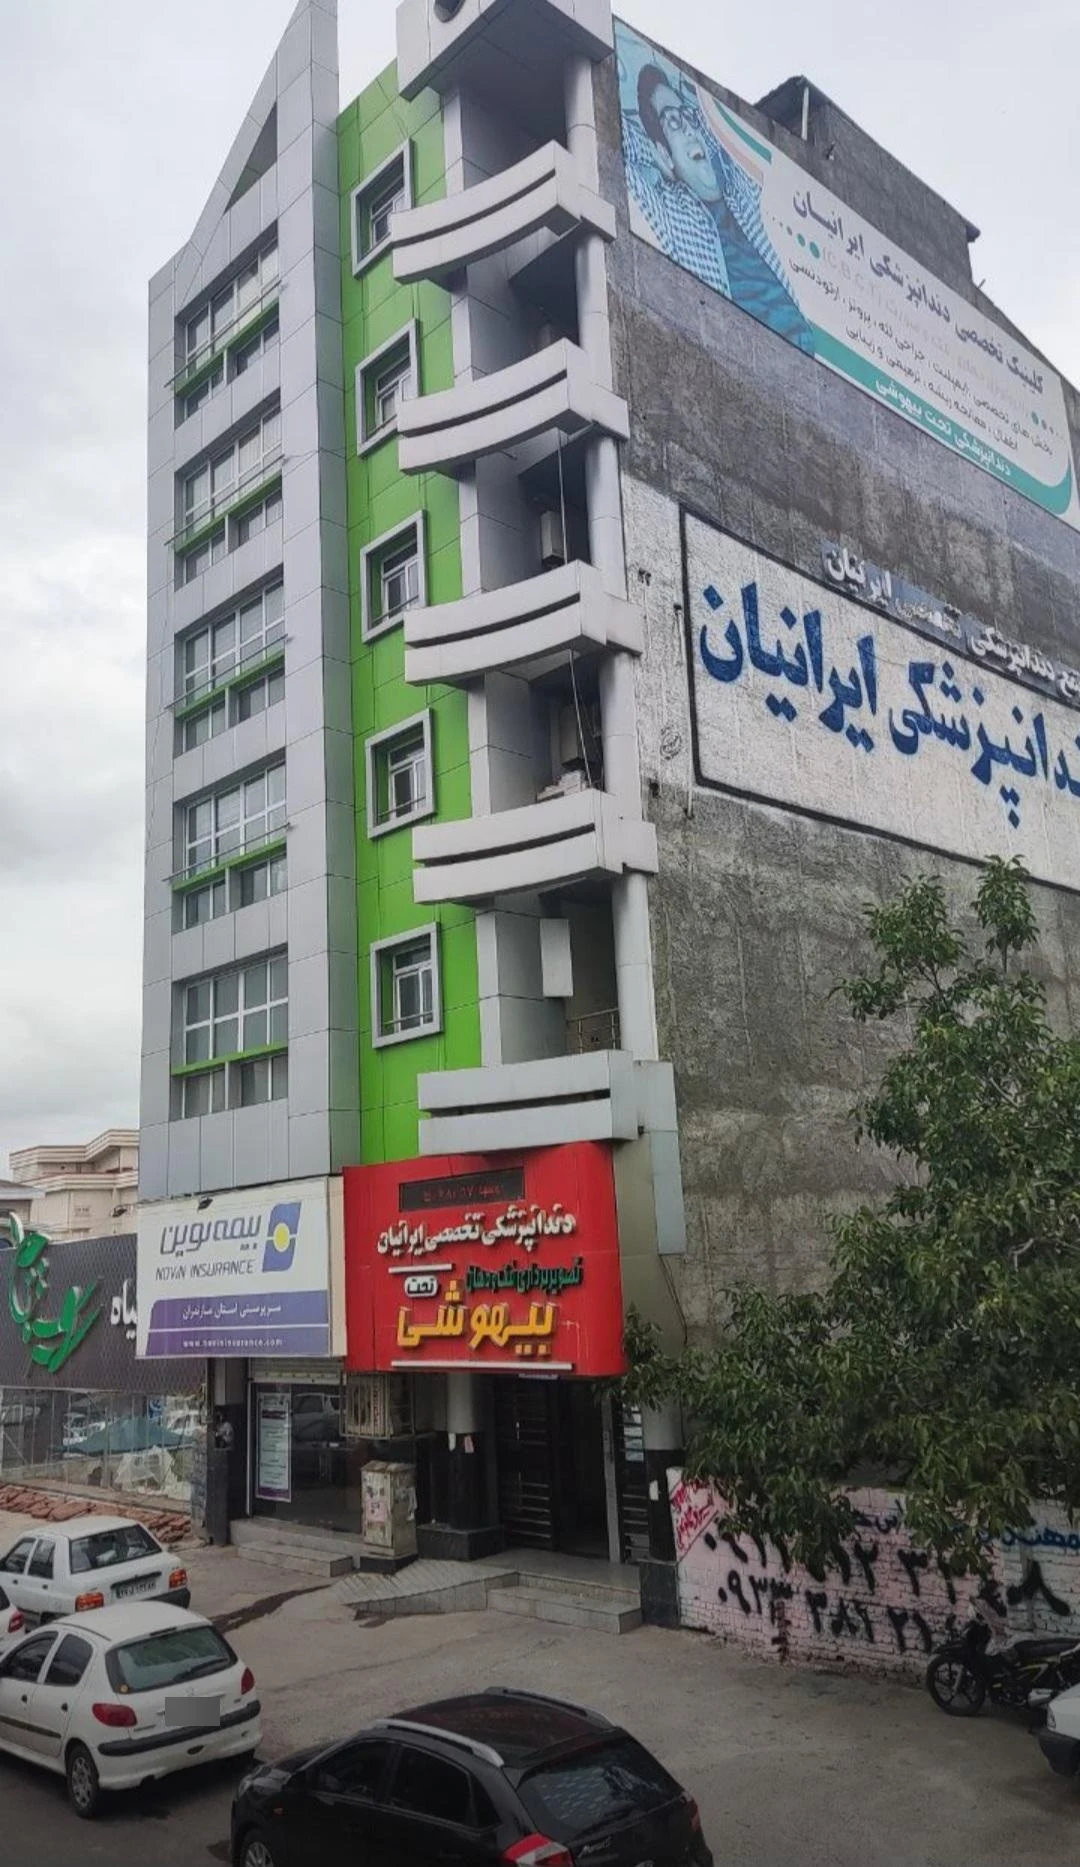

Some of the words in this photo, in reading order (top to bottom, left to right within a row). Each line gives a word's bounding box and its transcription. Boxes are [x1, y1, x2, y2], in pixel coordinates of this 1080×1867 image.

[792, 190, 865, 261] ایرانیان
[869, 254, 951, 323] دندانپزشکی
[955, 322, 1004, 364] تخصصی
[1006, 356, 1044, 395] کلینیک
[874, 378, 923, 421] بیهوشی
[924, 410, 952, 434] تحت
[953, 431, 1012, 476] دندانپزشکی
[698, 580, 878, 755] ایرانیان
[160, 1221, 213, 1257] نوین
[213, 1214, 262, 1251] بیمه
[376, 1219, 425, 1257] ایرانیان
[424, 1211, 484, 1252] تخصصی
[481, 1203, 577, 1253] دندانپزشکی
[155, 1264, 186, 1281] NOVIN
[190, 1259, 256, 1280] INSURANCE
[406, 1277, 435, 1293] تحت
[110, 1279, 138, 1341] یاه
[182, 1303, 213, 1321] مازندران
[214, 1300, 238, 1319] استان
[239, 1302, 282, 1320] سرپرستی
[396, 1280, 557, 1355] بیهوشی
